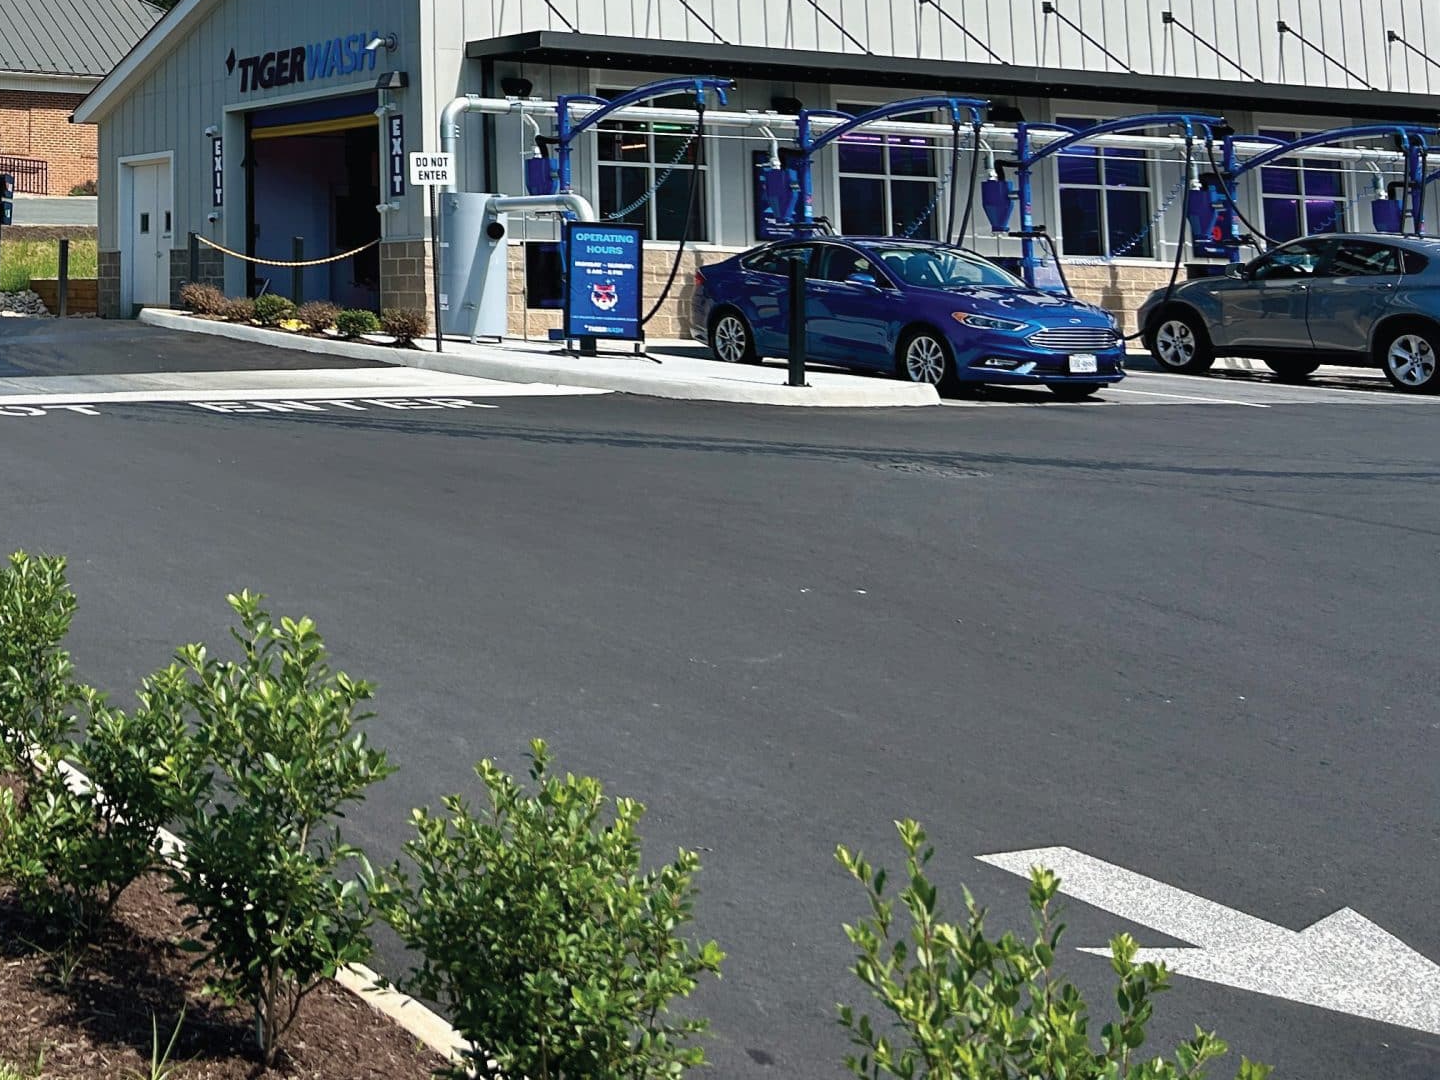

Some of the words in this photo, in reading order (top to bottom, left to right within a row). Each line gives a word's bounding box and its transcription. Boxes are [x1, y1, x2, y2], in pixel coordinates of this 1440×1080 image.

[238, 31, 379, 93] TIGERWASH
[392, 118, 402, 194] EXIT
[416, 157, 428, 168] DO
[431, 157, 448, 168] NOT
[214, 140, 223, 204] EXIT
[418, 170, 448, 181] ENTER
[576, 233, 633, 243] OPERATING
[586, 245, 623, 254] HOURS
[189, 398, 500, 413] ENTER
